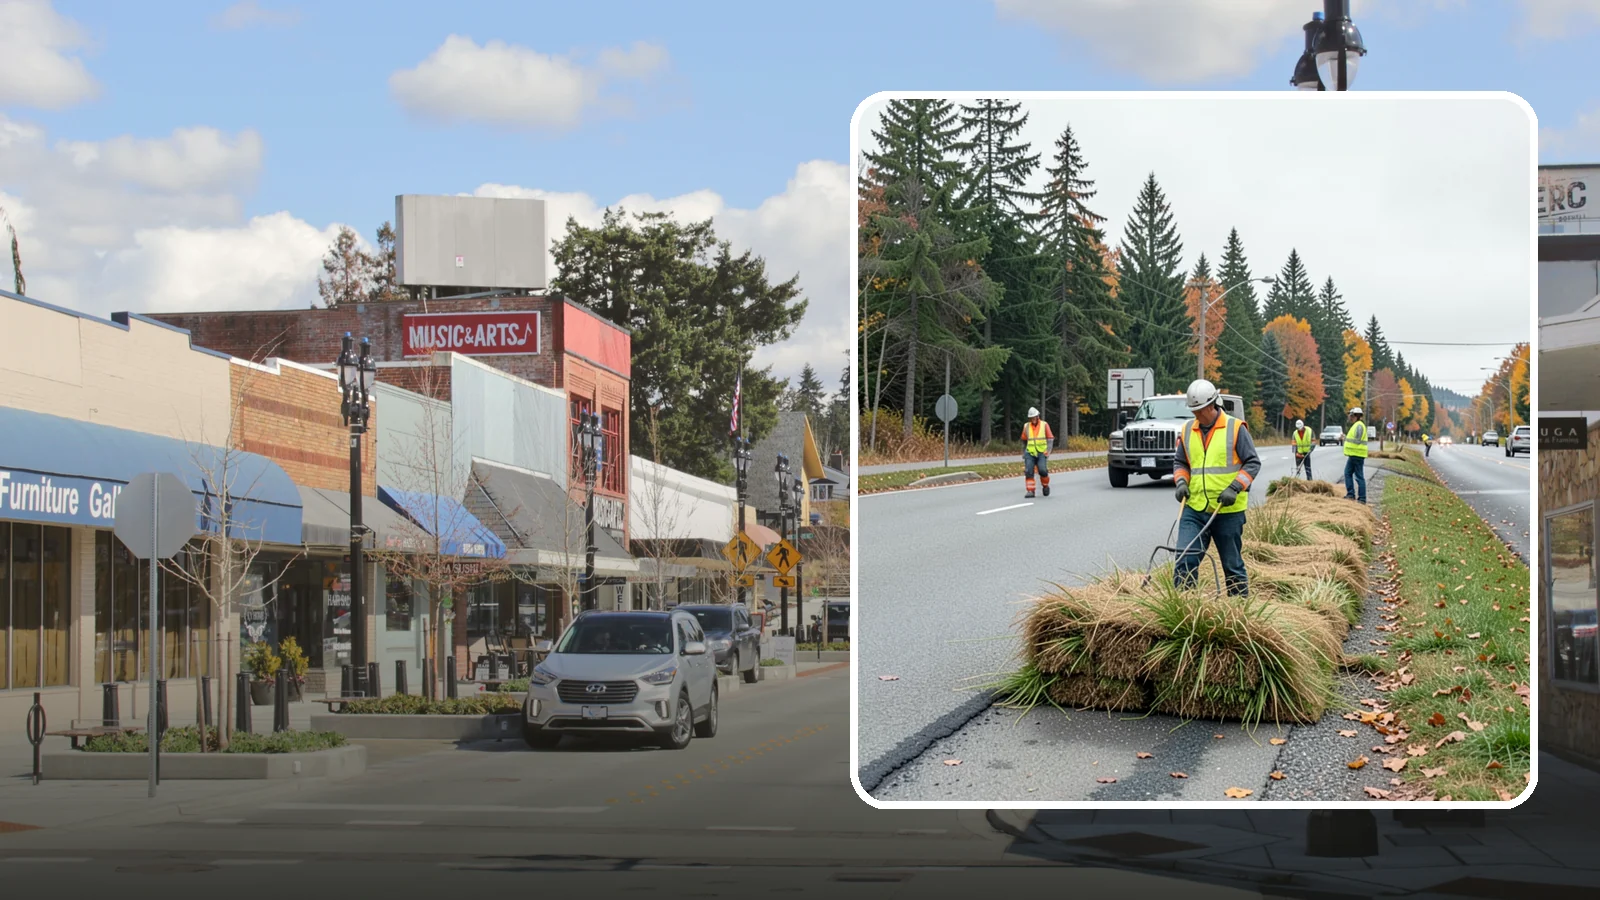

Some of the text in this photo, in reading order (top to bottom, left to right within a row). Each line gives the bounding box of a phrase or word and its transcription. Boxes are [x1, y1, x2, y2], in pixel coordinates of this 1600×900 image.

[0, 471, 121, 519] Furniture Gal
[453, 563, 479, 574] SUSHI
